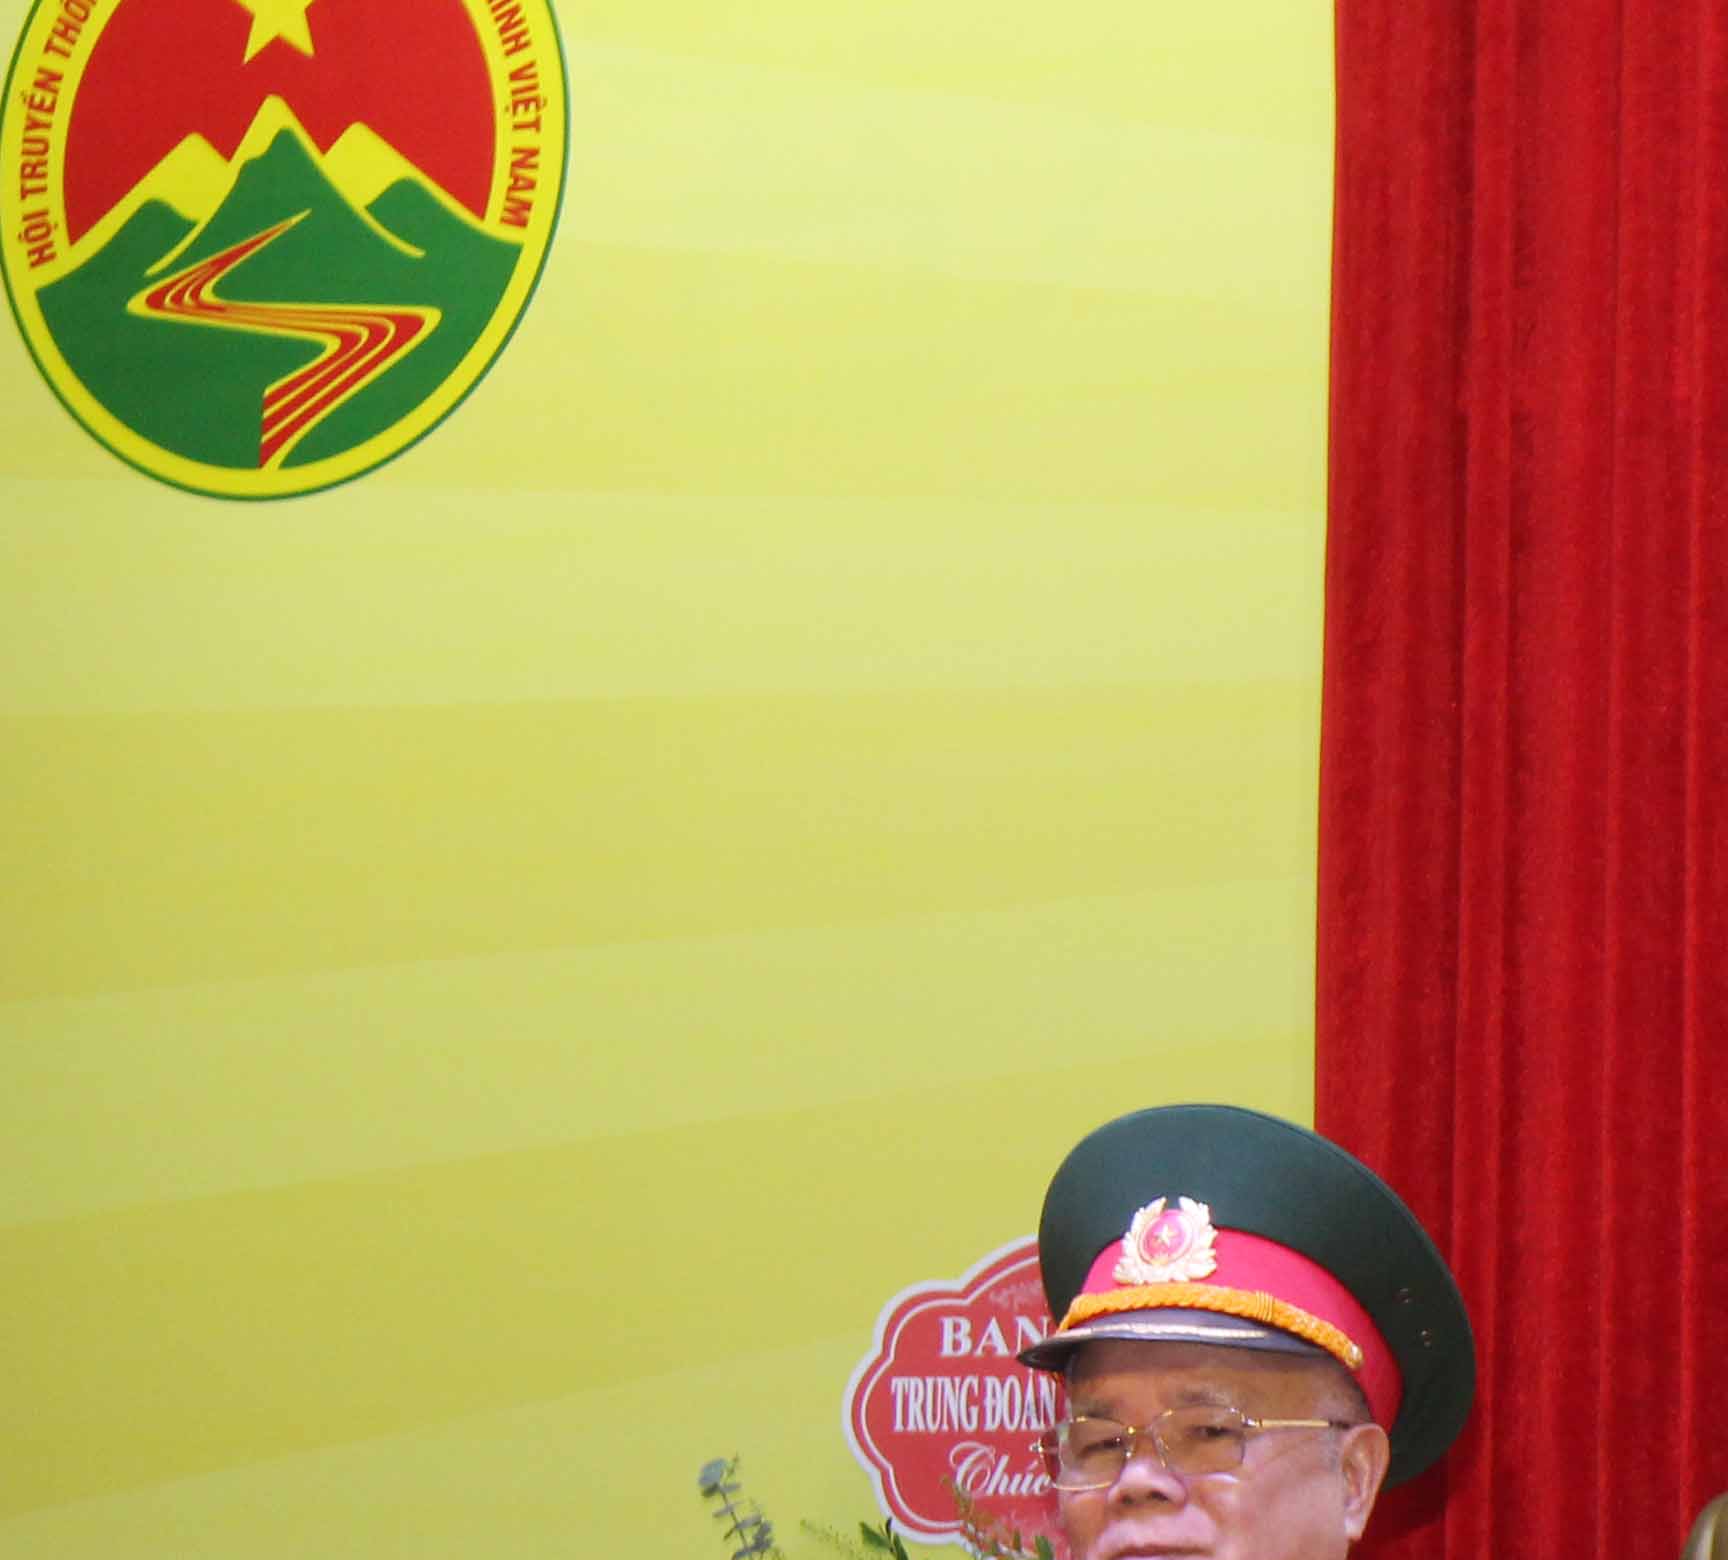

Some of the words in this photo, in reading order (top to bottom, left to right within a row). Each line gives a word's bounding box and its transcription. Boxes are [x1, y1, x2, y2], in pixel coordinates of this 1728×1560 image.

[505, 61, 547, 133] VIỆT
[20, 67, 64, 200] TRUYỀN
[500, 147, 541, 229] NAM
[18, 209, 58, 268] HỘI
[939, 1315, 1050, 1357] BAN
[890, 1375, 979, 1433] TRUNG
[983, 1368, 1057, 1433] ĐOÀN
[949, 1441, 1052, 1497] Chúc
